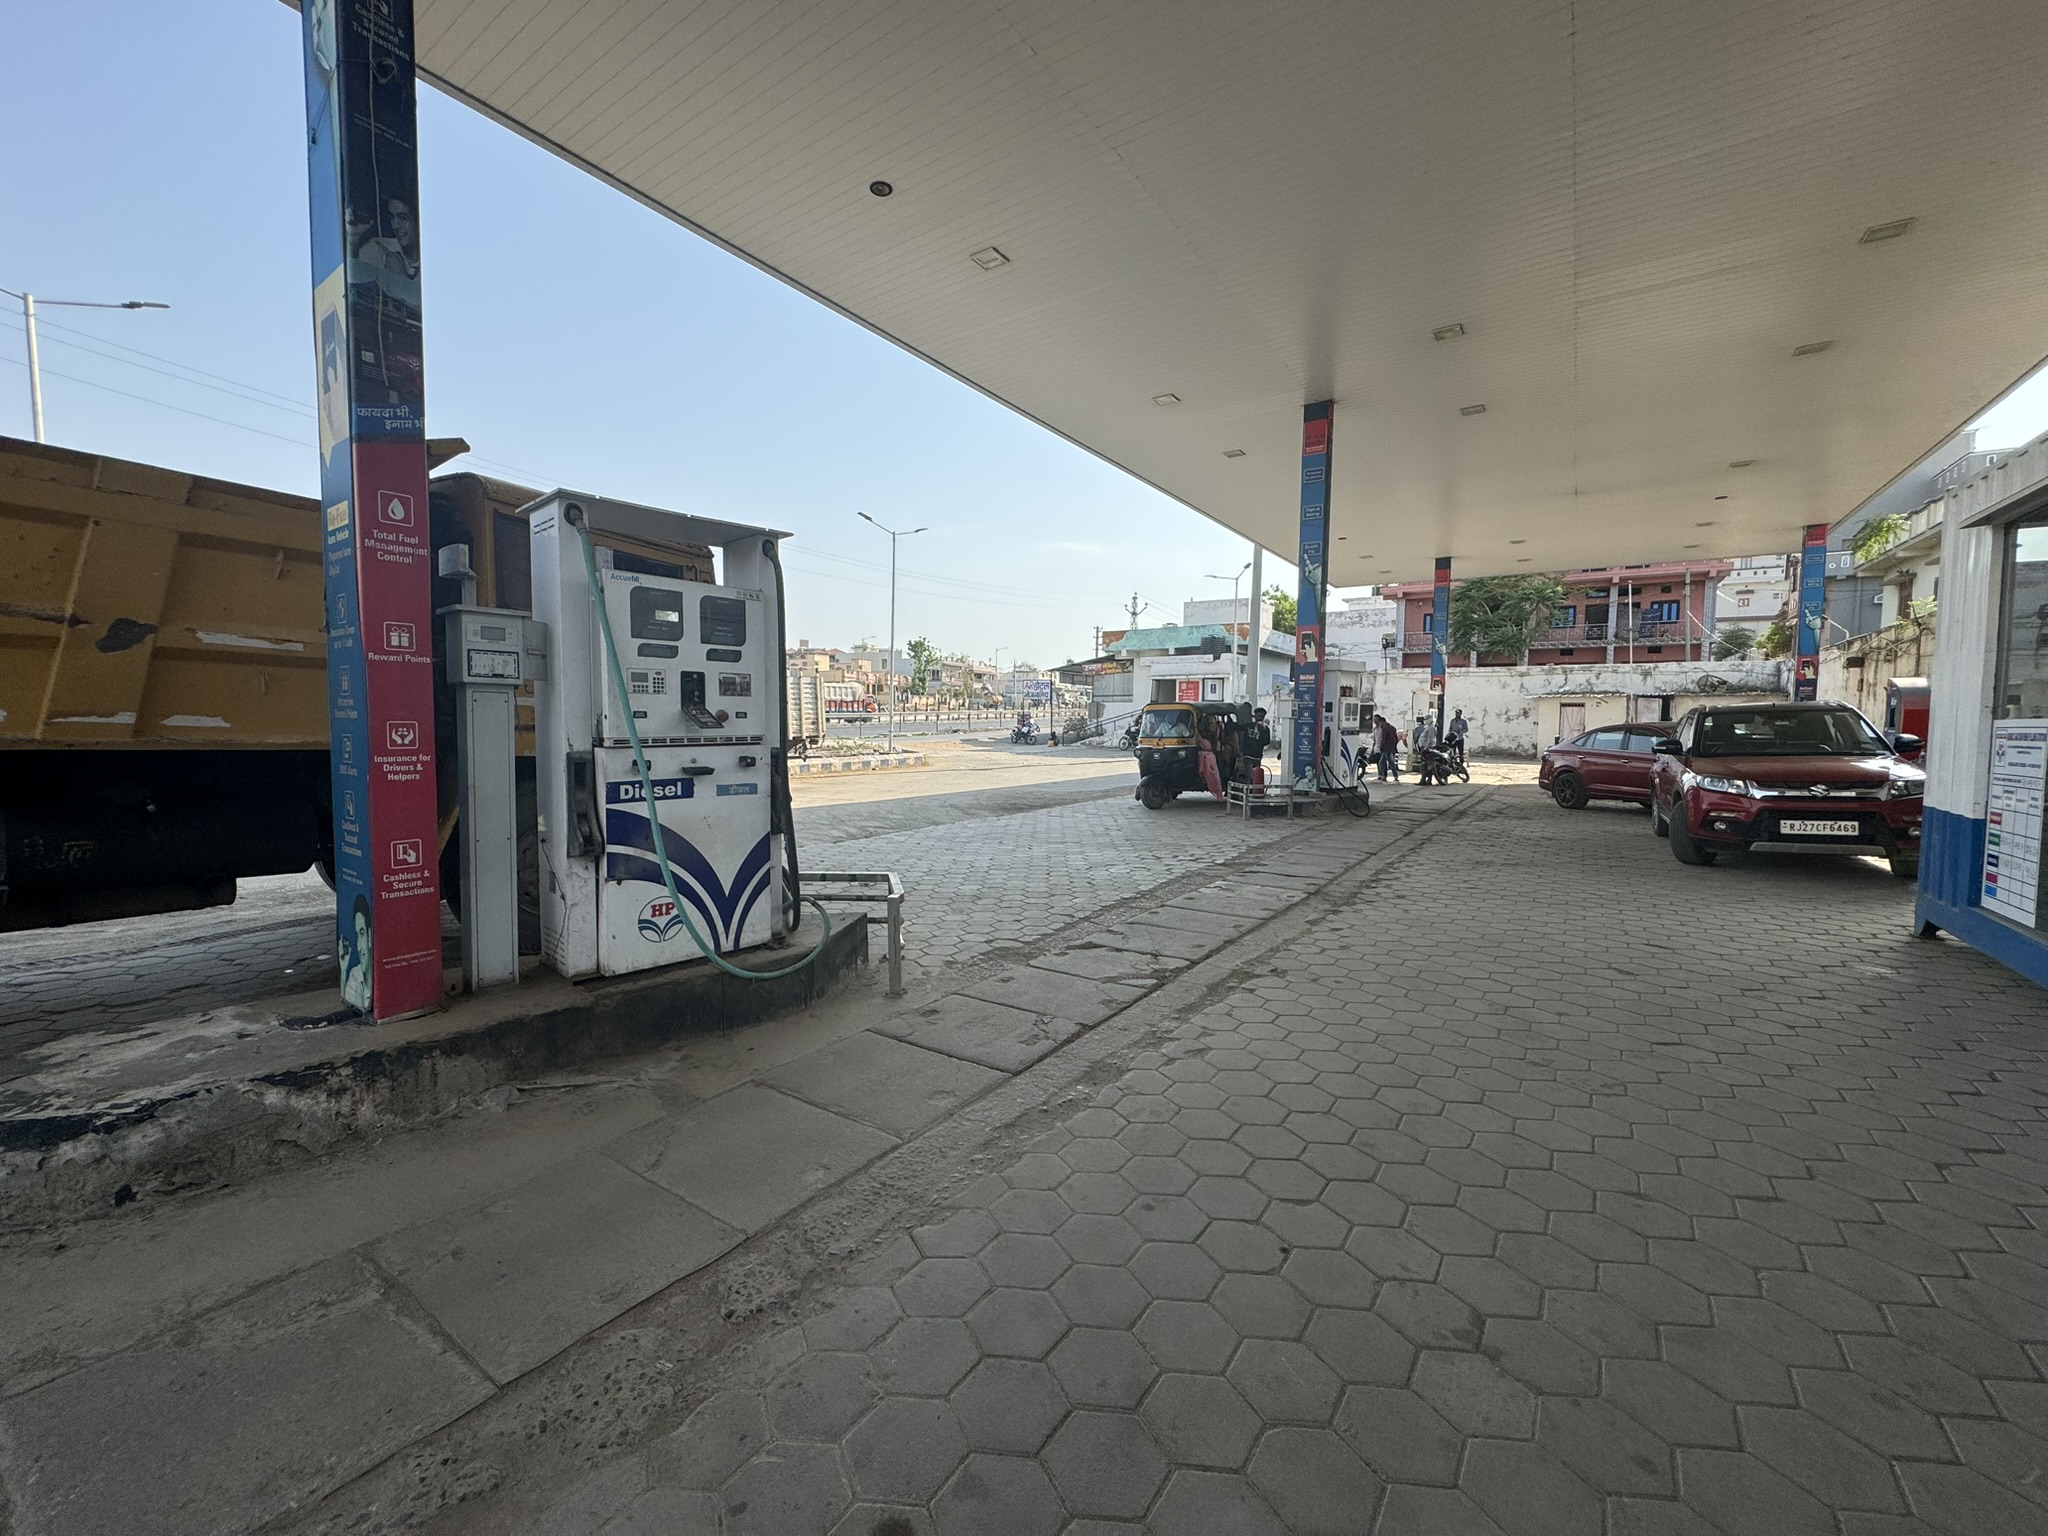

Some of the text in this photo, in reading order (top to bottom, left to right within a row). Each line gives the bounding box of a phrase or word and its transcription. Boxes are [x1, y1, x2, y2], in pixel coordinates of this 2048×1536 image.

[362, 18, 399, 44] Scured
[357, 407, 394, 418] फायदा
[384, 419, 413, 430] इनाम
[372, 529, 418, 544] Total Fuel
[377, 552, 412, 564] Control
[368, 652, 431, 664] Reward Points
[419, 754, 431, 762] for
[383, 764, 414, 772] Drivers
[388, 773, 420, 782] Helpers
[1789, 822, 1856, 832] RJ27CF6469
[383, 872, 421, 882] Cashless
[392, 880, 422, 890] Secure
[380, 886, 435, 900] Transactions
[650, 902, 676, 918] HP
